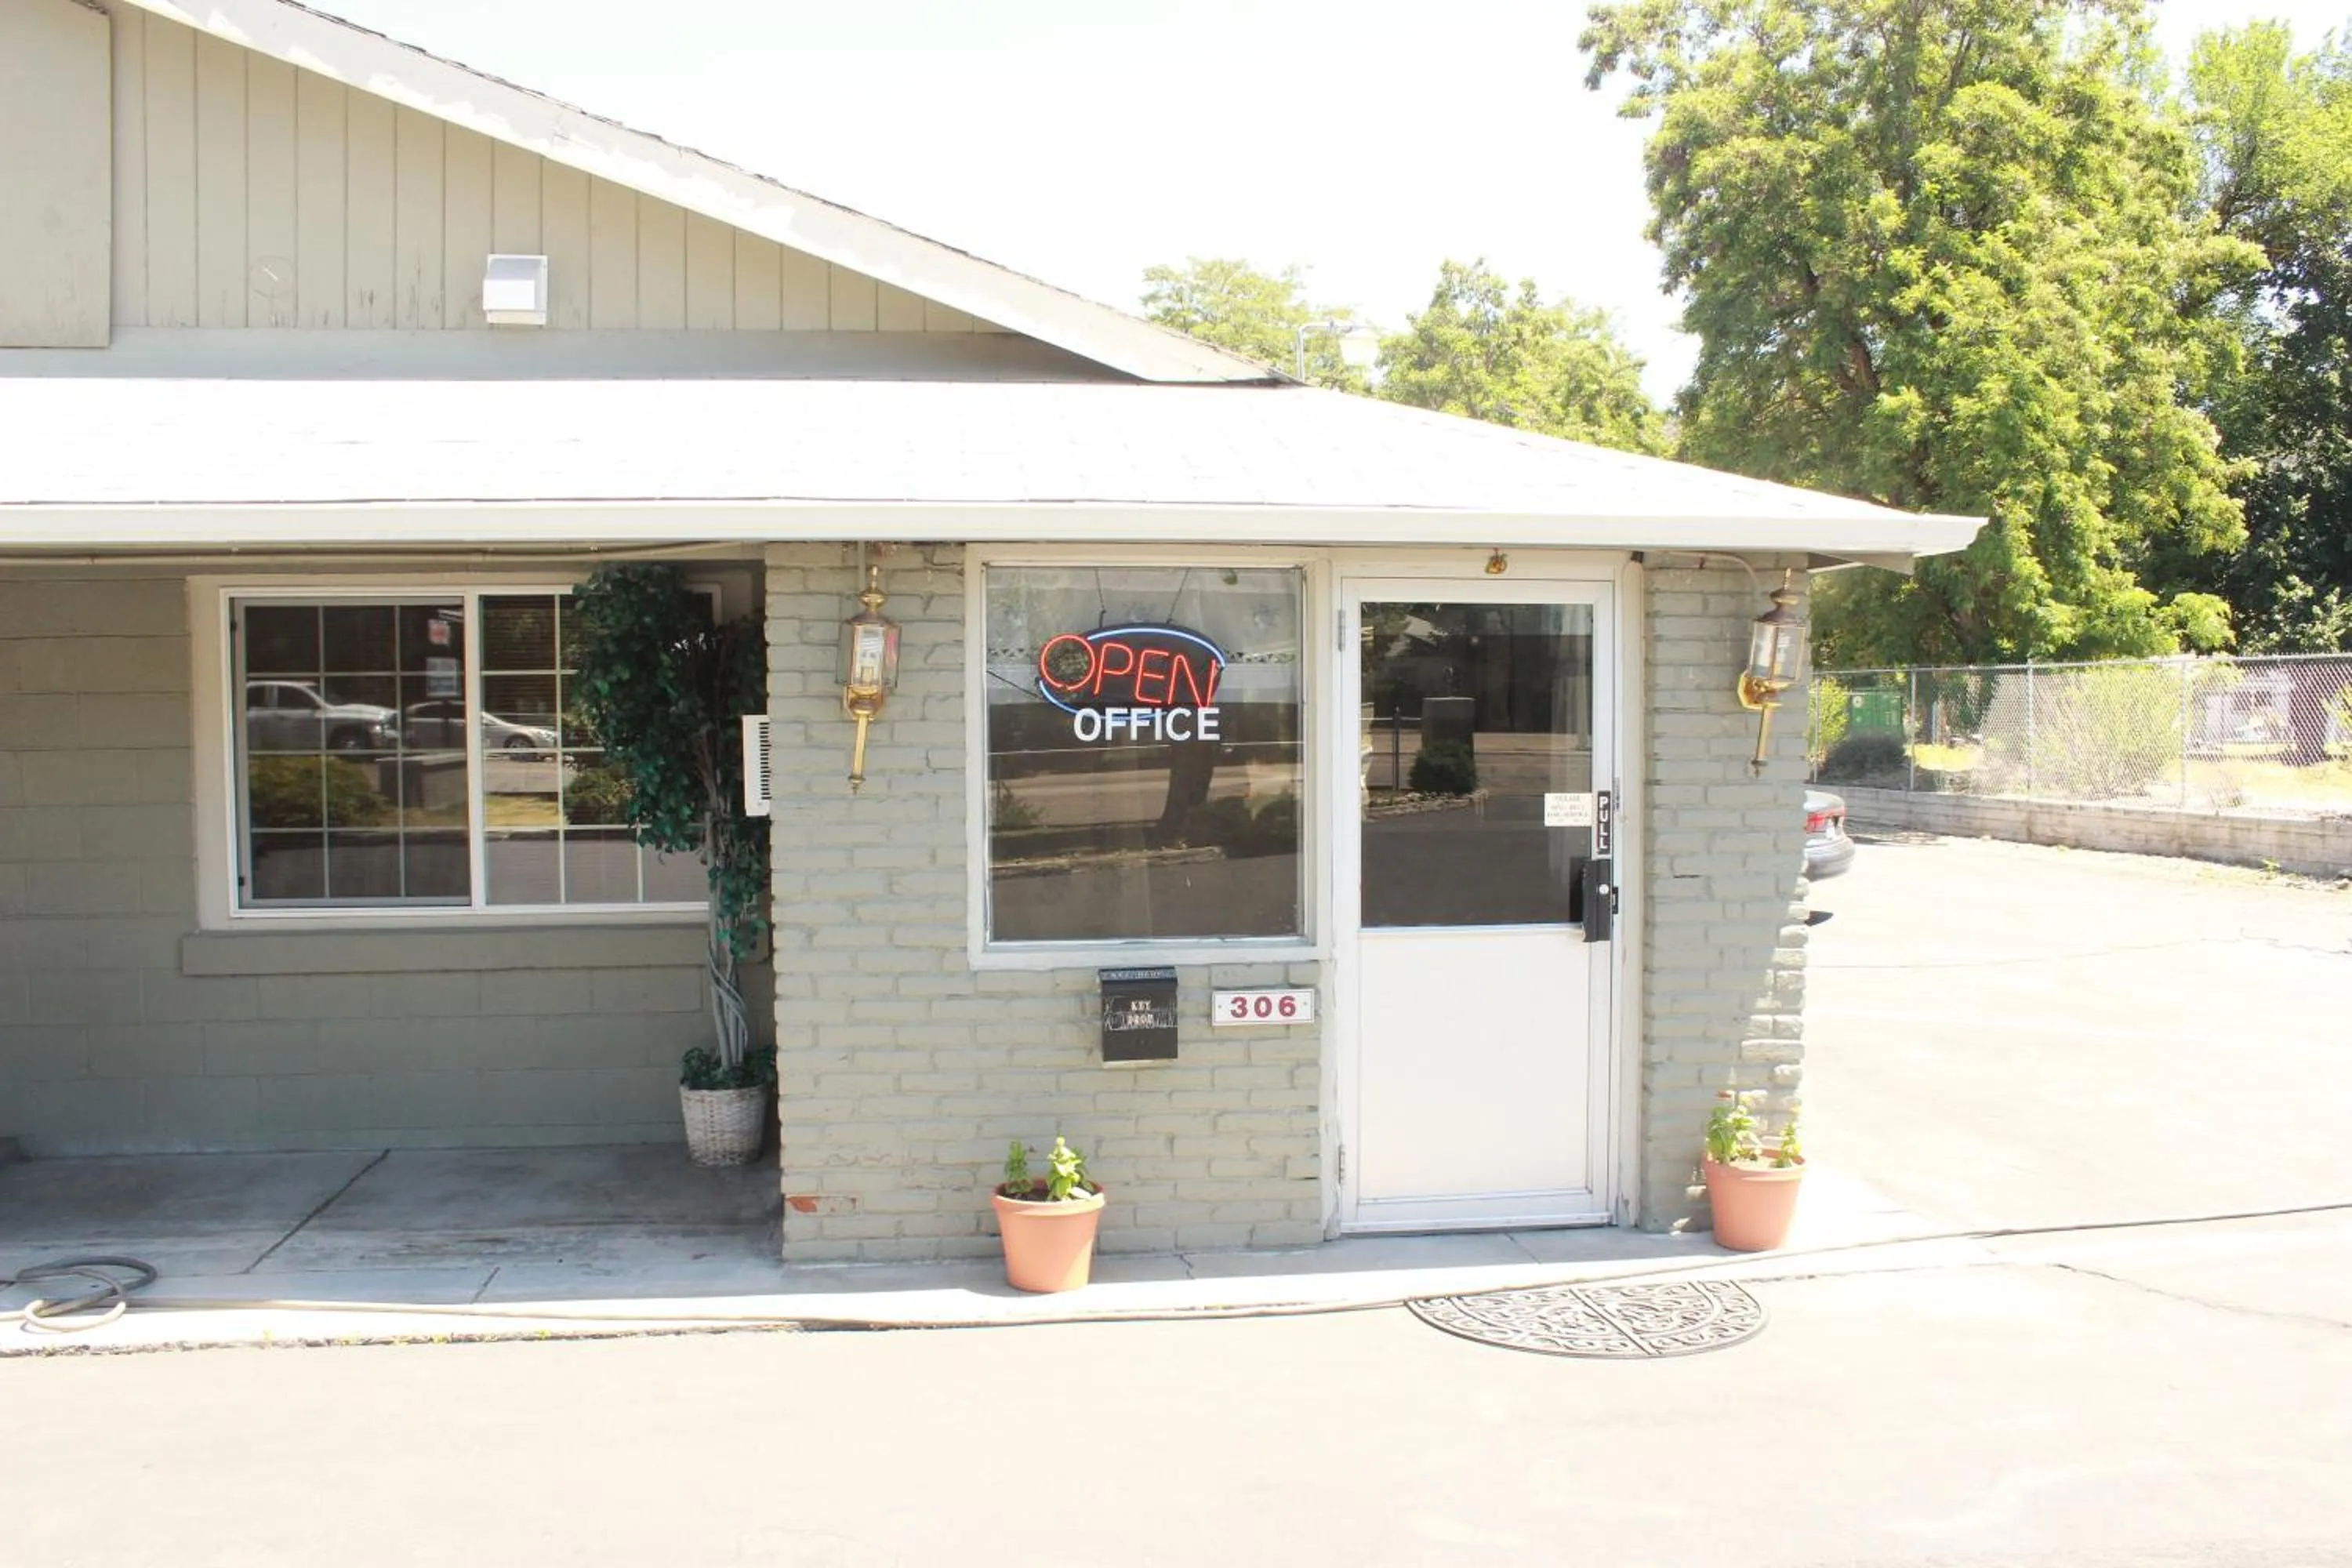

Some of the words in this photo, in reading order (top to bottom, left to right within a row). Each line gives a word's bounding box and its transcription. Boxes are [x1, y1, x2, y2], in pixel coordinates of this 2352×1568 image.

[1040, 633, 1218, 707] OPEN
[1073, 707, 1221, 742] OFFICE
[1599, 795, 1609, 849] PULL
[1230, 996, 1297, 1018] 306
